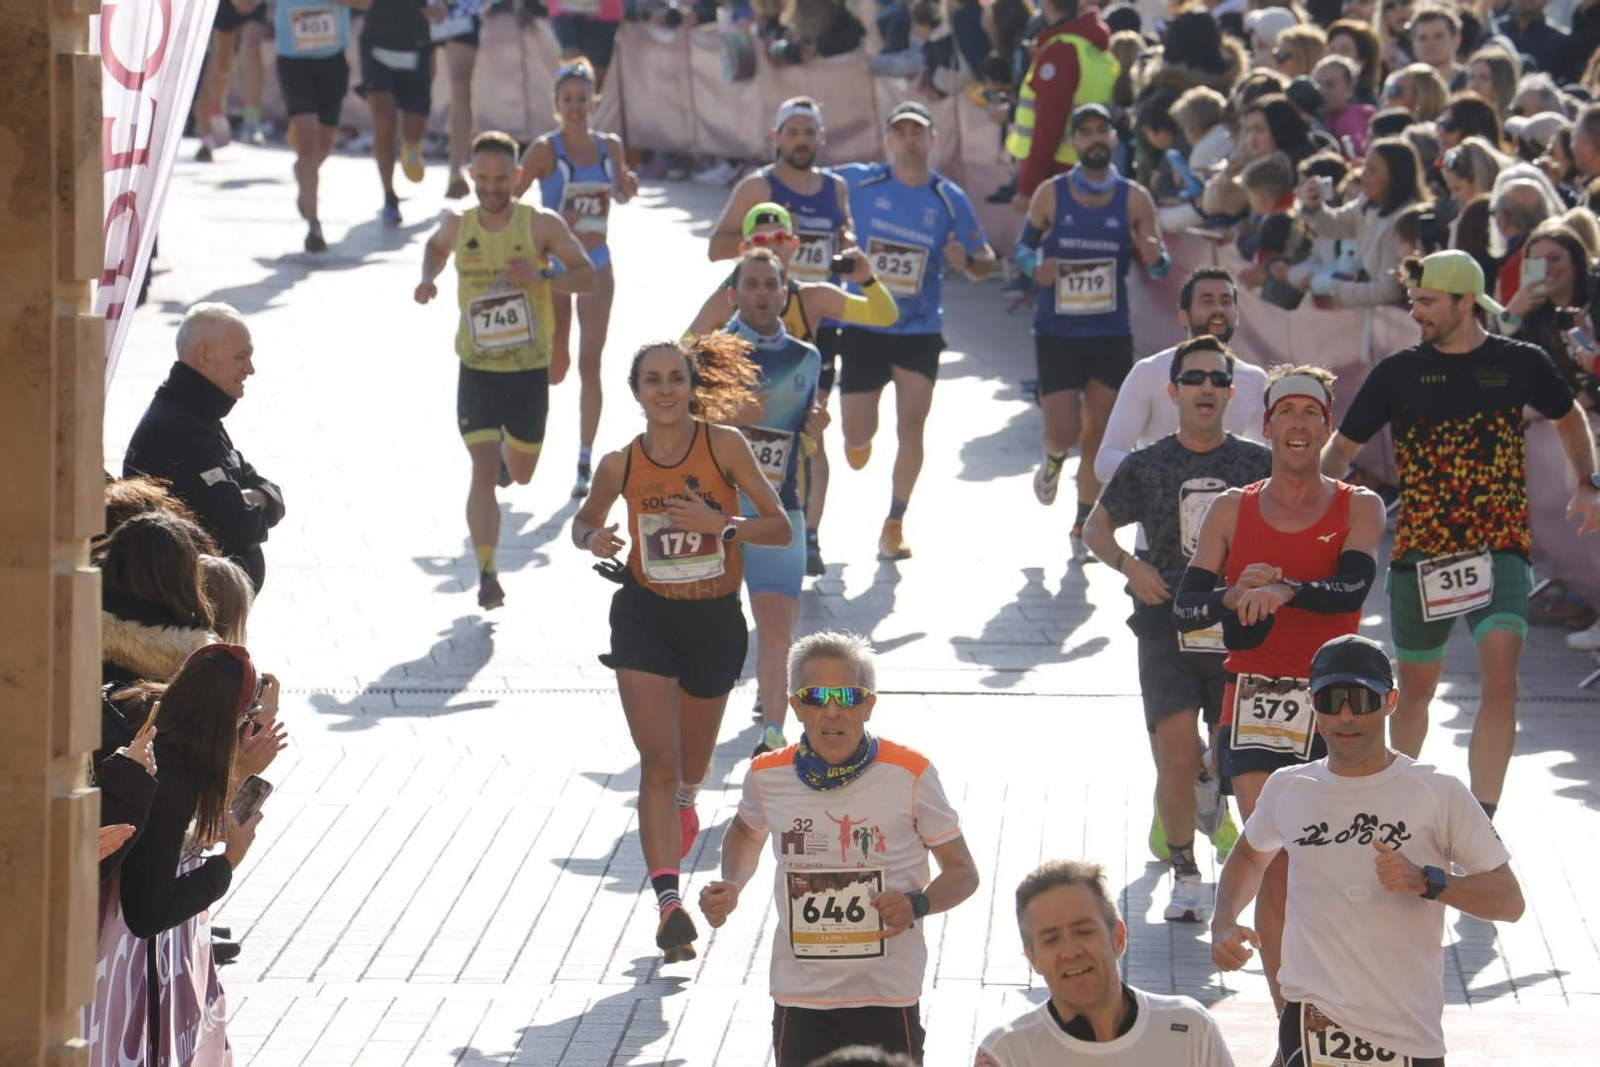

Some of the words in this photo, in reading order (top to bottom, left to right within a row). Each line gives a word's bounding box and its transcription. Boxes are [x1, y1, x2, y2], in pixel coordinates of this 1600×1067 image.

[876, 255, 913, 275] 825
[1068, 275, 1104, 292] 1719
[481, 308, 519, 328] 748
[660, 531, 702, 556] 179
[1439, 566, 1479, 590] 315
[1252, 696, 1300, 722] 579
[793, 818, 813, 833] 32
[803, 896, 866, 924] 646
